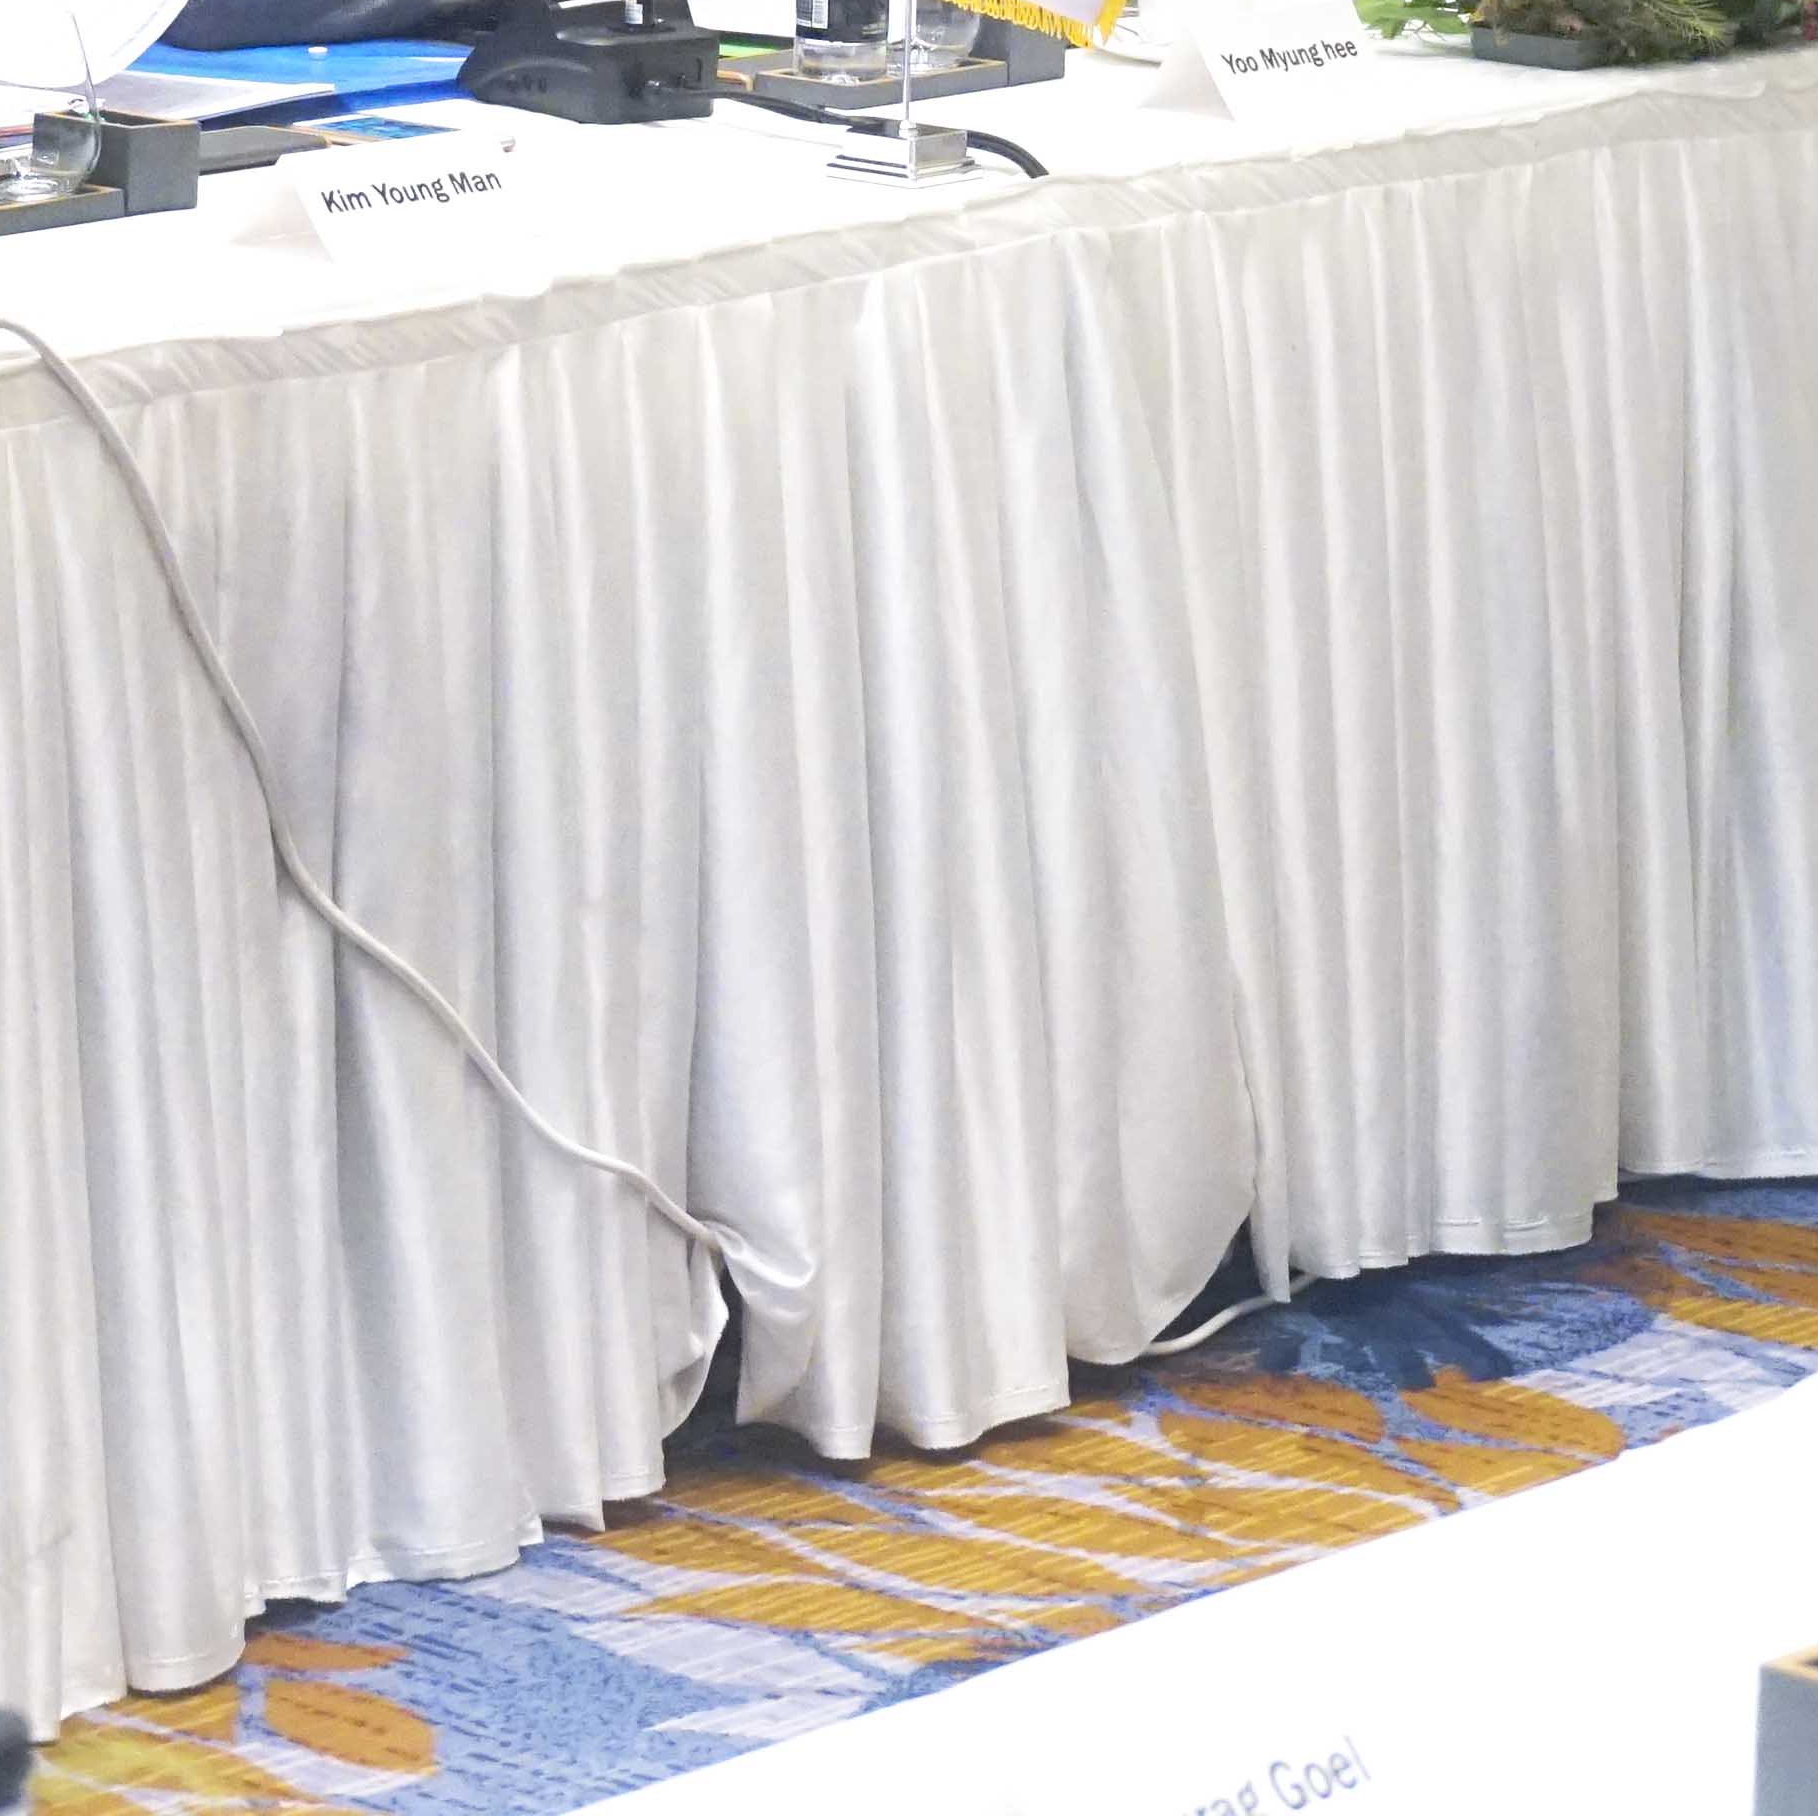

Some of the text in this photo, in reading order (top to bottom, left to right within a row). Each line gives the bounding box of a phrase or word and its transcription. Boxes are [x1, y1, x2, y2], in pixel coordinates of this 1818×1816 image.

[1220, 39, 1358, 75] Yoo Myung hee
[320, 171, 503, 214] Kim Young Man
[1268, 1734, 1371, 1811] Goel
